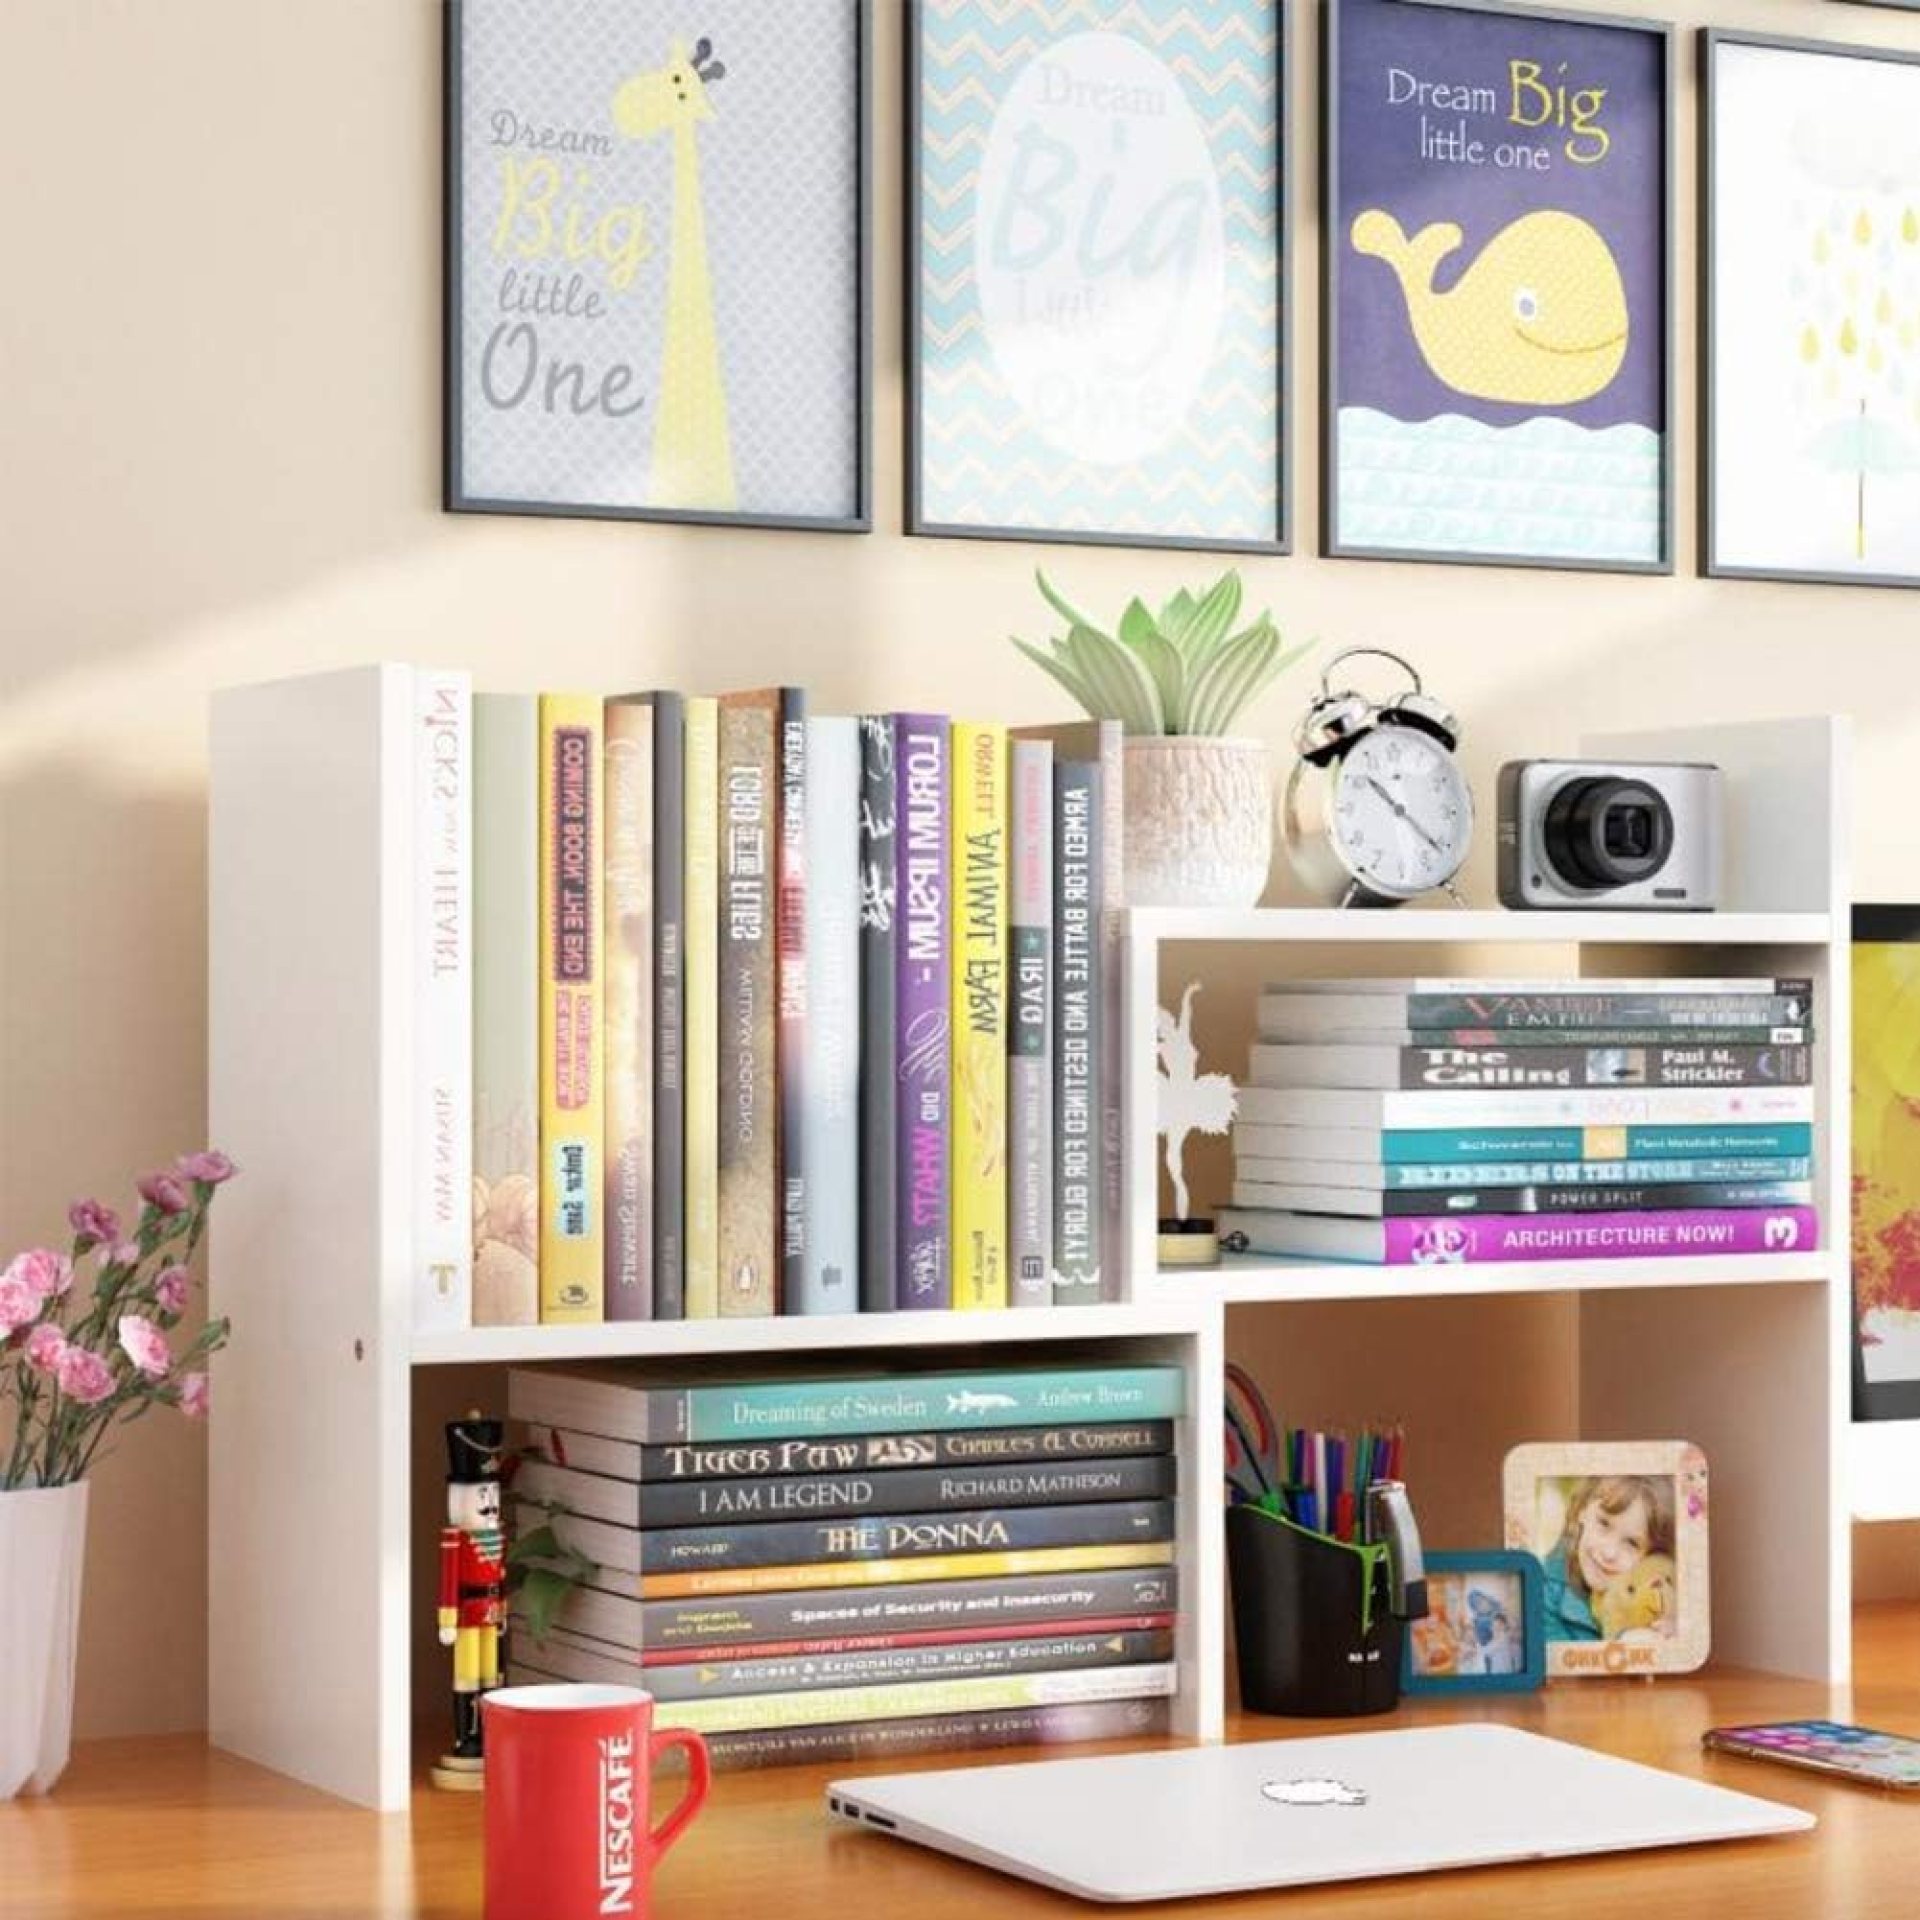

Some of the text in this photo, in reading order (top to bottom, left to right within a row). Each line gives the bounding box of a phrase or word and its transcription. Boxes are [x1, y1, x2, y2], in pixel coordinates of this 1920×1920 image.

[1038, 62, 1167, 116] Dream
[1387, 60, 1610, 163] Dream Big
[491, 109, 613, 155] Dream
[1421, 115, 1550, 170] little one
[491, 155, 655, 290] Big
[499, 268, 607, 319] little
[481, 322, 645, 417] One
[1422, 1048, 1508, 1066] The
[1661, 1066, 1745, 1082] Strickler
[1662, 1049, 1736, 1064] Paul M.
[1423, 1065, 1570, 1085] Calling
[1503, 1225, 1672, 1249] ARCHITECTURE
[1676, 1225, 1735, 1242] NOW!
[733, 1400, 829, 1425] Dreaming
[831, 1398, 849, 1419] of
[851, 1393, 926, 1418] Sweden
[699, 1487, 708, 1514] I
[715, 1486, 763, 1512] AM
[769, 1481, 873, 1509] LEGEND
[941, 1476, 1024, 1499] RICHARD
[816, 1527, 881, 1552] THE
[887, 1520, 1010, 1550] DONNA
[790, 1589, 1096, 1623] Spaces of Security and Insecurity
[730, 1664, 797, 1681] Access
[599, 1727, 634, 1915] NESCAFÉ
